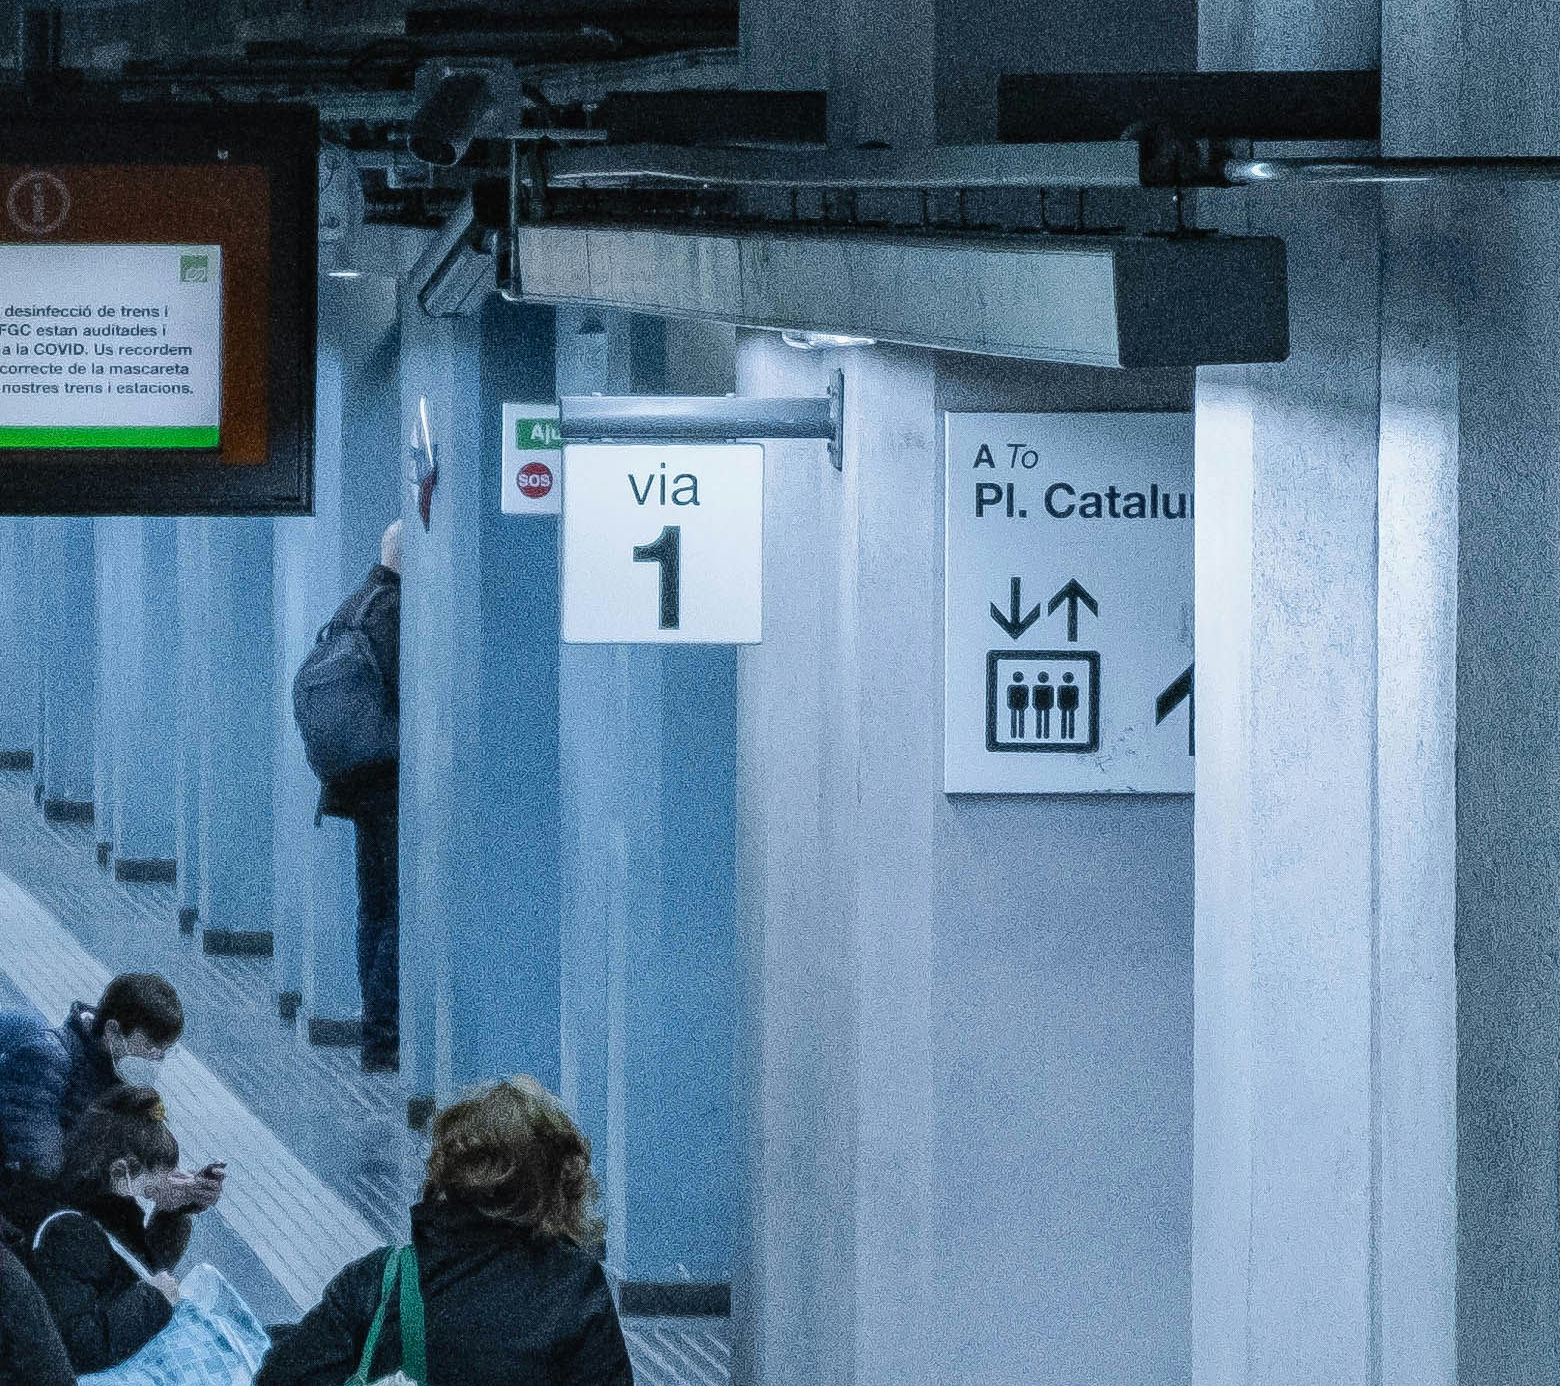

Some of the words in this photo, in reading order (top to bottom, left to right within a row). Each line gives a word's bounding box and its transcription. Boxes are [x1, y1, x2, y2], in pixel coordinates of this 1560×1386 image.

[4, 305, 92, 317] desinfecció
[97, 305, 116, 318] de
[121, 306, 160, 318] trens
[36, 325, 78, 336] estan
[83, 324, 157, 337] auditades
[16, 344, 29, 356] la
[33, 343, 88, 356] COVID.
[94, 343, 114, 356] Us
[118, 344, 193, 356] recordem
[0, 363, 63, 375] correcte
[68, 363, 87, 375] de
[91, 363, 104, 375] la
[109, 363, 189, 375] mascareta
[2, 382, 59, 394] nostres
[64, 383, 103, 394] trens
[116, 383, 193, 394] estacions.
[972, 443, 996, 469] A
[1007, 443, 1039, 470] To
[517, 473, 551, 488] SOS
[627, 461, 702, 507] via
[974, 482, 1028, 518] Pl.
[1043, 482, 1194, 519] Catalu
[633, 524, 681, 630] 1
